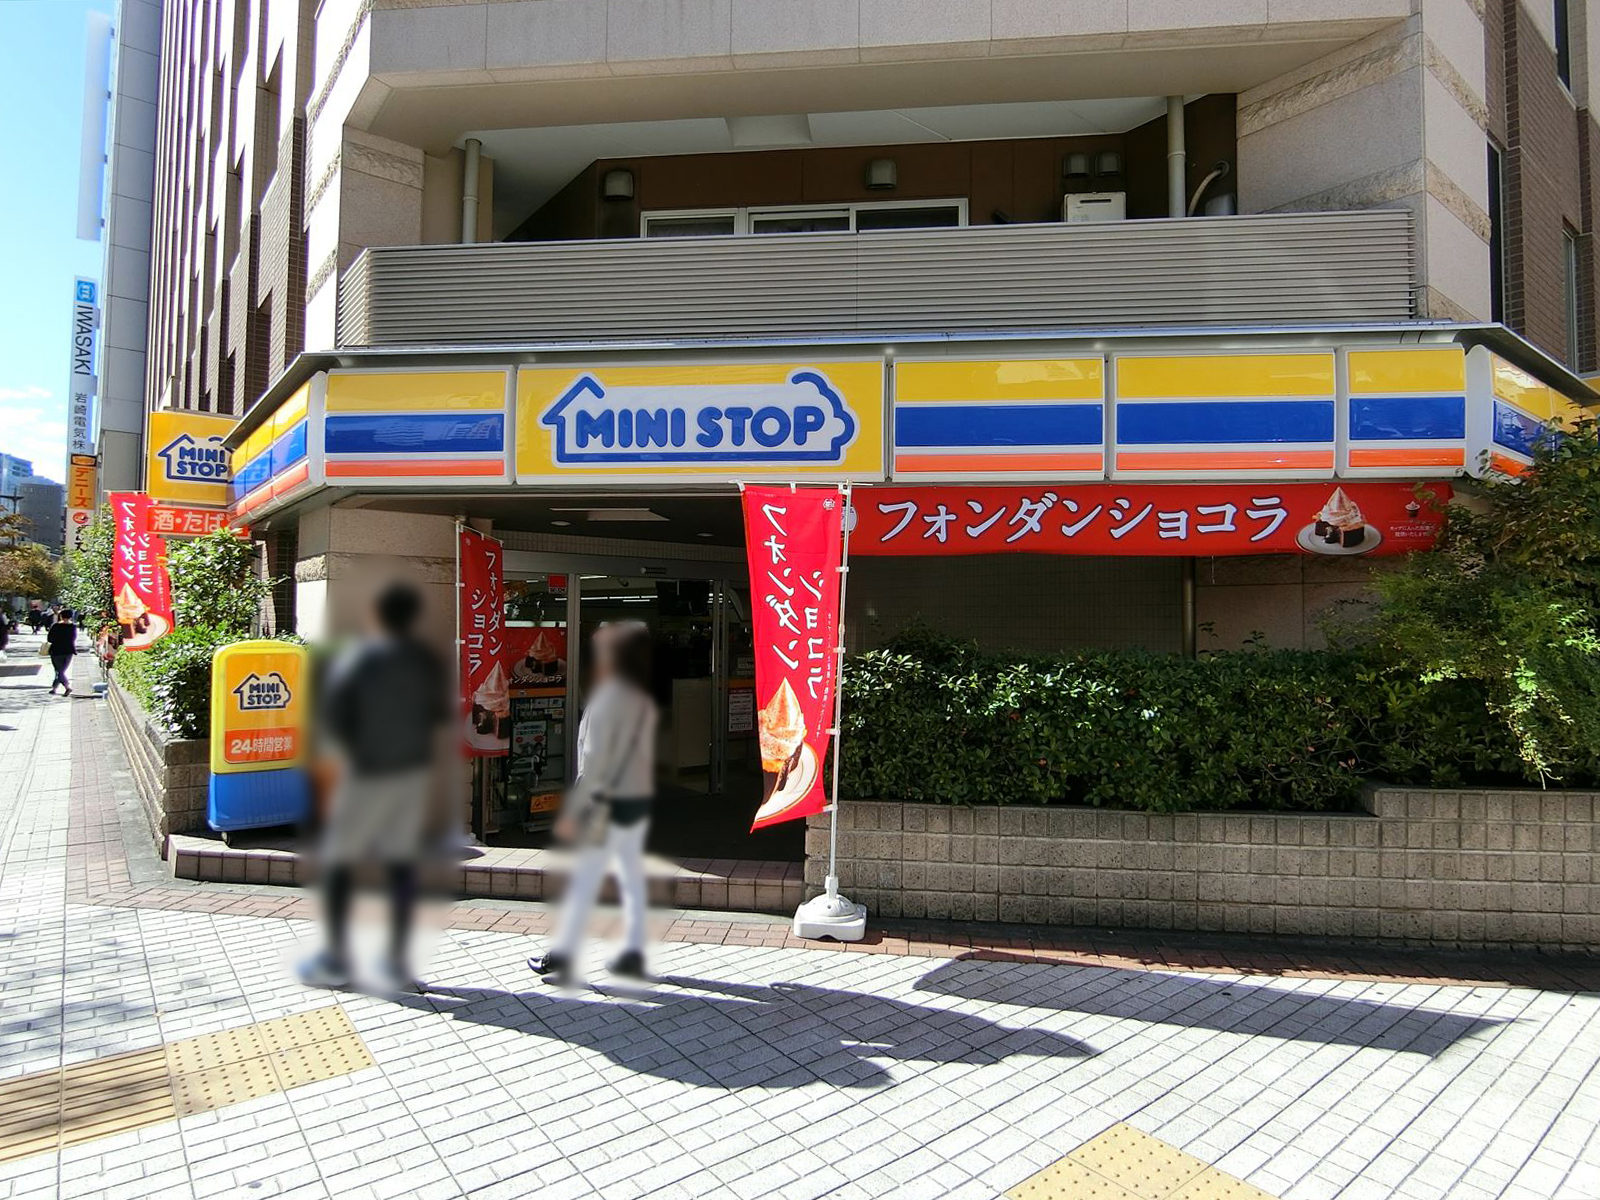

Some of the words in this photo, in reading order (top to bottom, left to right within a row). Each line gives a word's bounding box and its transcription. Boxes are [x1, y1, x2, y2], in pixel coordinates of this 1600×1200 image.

[74, 304, 93, 376] IWASAKI
[576, 408, 686, 448] MINI
[696, 406, 825, 448] STOP
[177, 461, 228, 477] STOP
[179, 446, 225, 463] MINI
[74, 467, 93, 508] デニーズ
[878, 492, 1288, 543] フォンダンショコラ
[485, 551, 503, 656] フォンダン
[467, 588, 487, 676] ショコラ
[247, 694, 281, 705] STOP
[249, 683, 280, 693] MINI
[231, 736, 293, 754] 24時間営業
